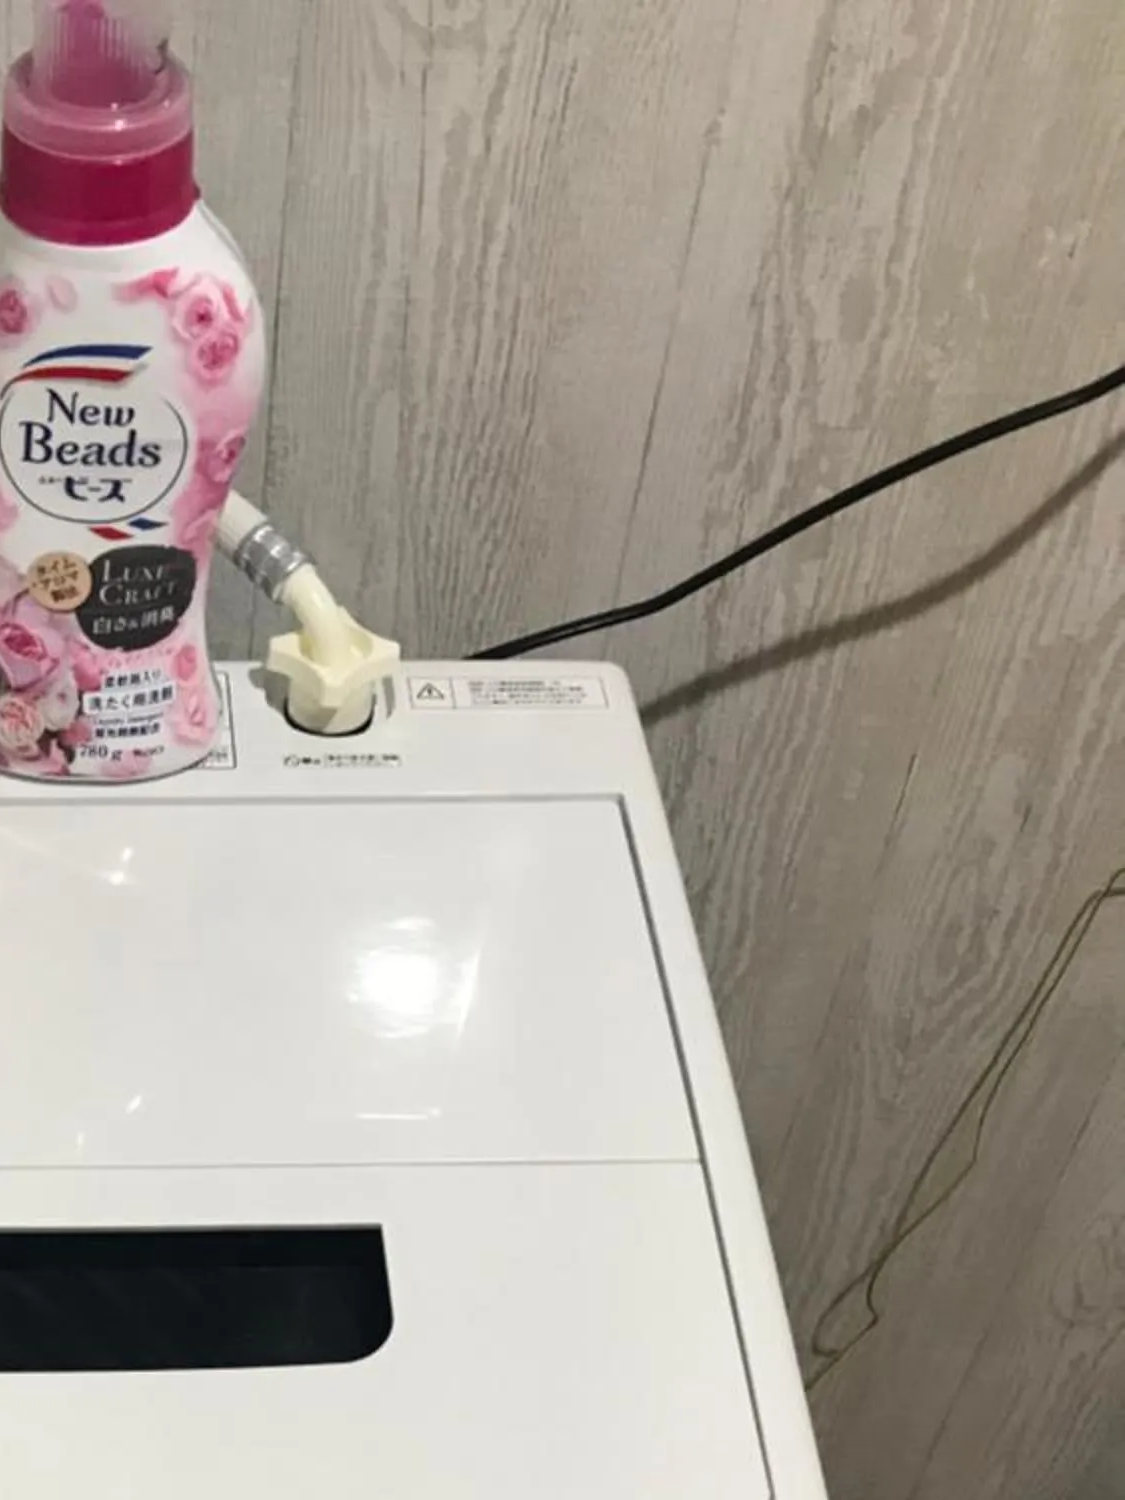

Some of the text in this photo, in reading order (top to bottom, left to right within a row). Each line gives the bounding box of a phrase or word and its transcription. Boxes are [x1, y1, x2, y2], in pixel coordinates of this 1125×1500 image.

[46, 387, 135, 427] New
[19, 421, 162, 467] Beads
[99, 580, 178, 606] CRAFT
